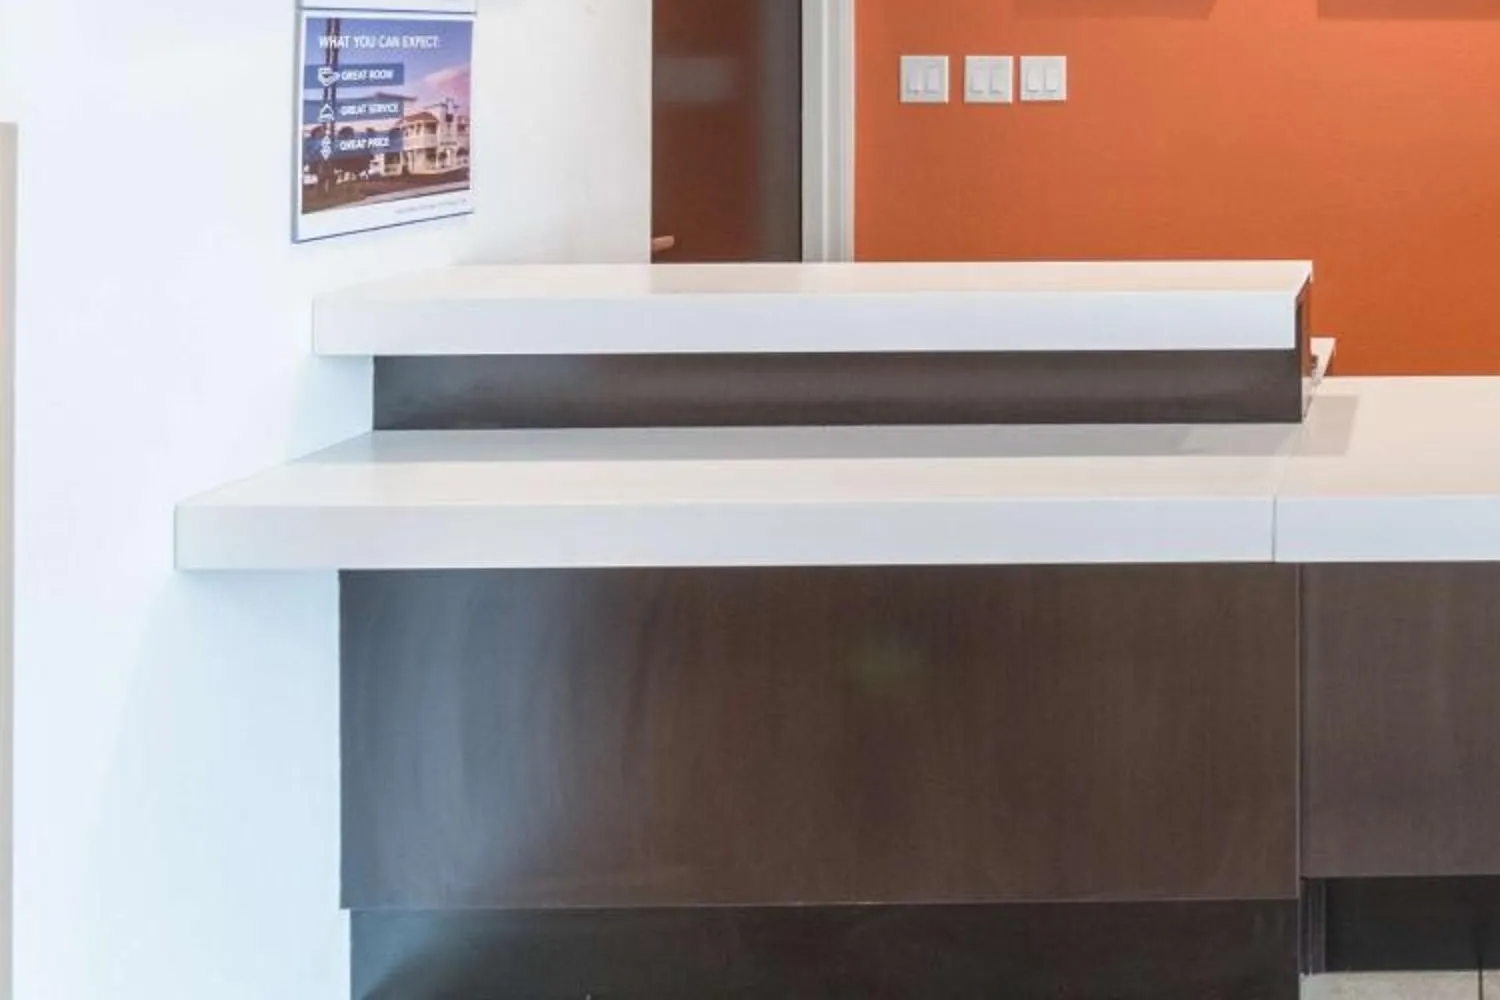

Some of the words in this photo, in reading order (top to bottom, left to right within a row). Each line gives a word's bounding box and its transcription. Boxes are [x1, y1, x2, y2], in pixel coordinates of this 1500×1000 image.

[319, 36, 349, 48] WHAT
[354, 36, 376, 48] YOU
[380, 36, 400, 48] CAN
[341, 70, 367, 81] GREAT
[369, 69, 395, 80] ROOM
[341, 104, 367, 115] GREAT
[368, 103, 400, 113] SERVICE
[340, 139, 367, 151] GREAT
[367, 137, 390, 148] PRICE
